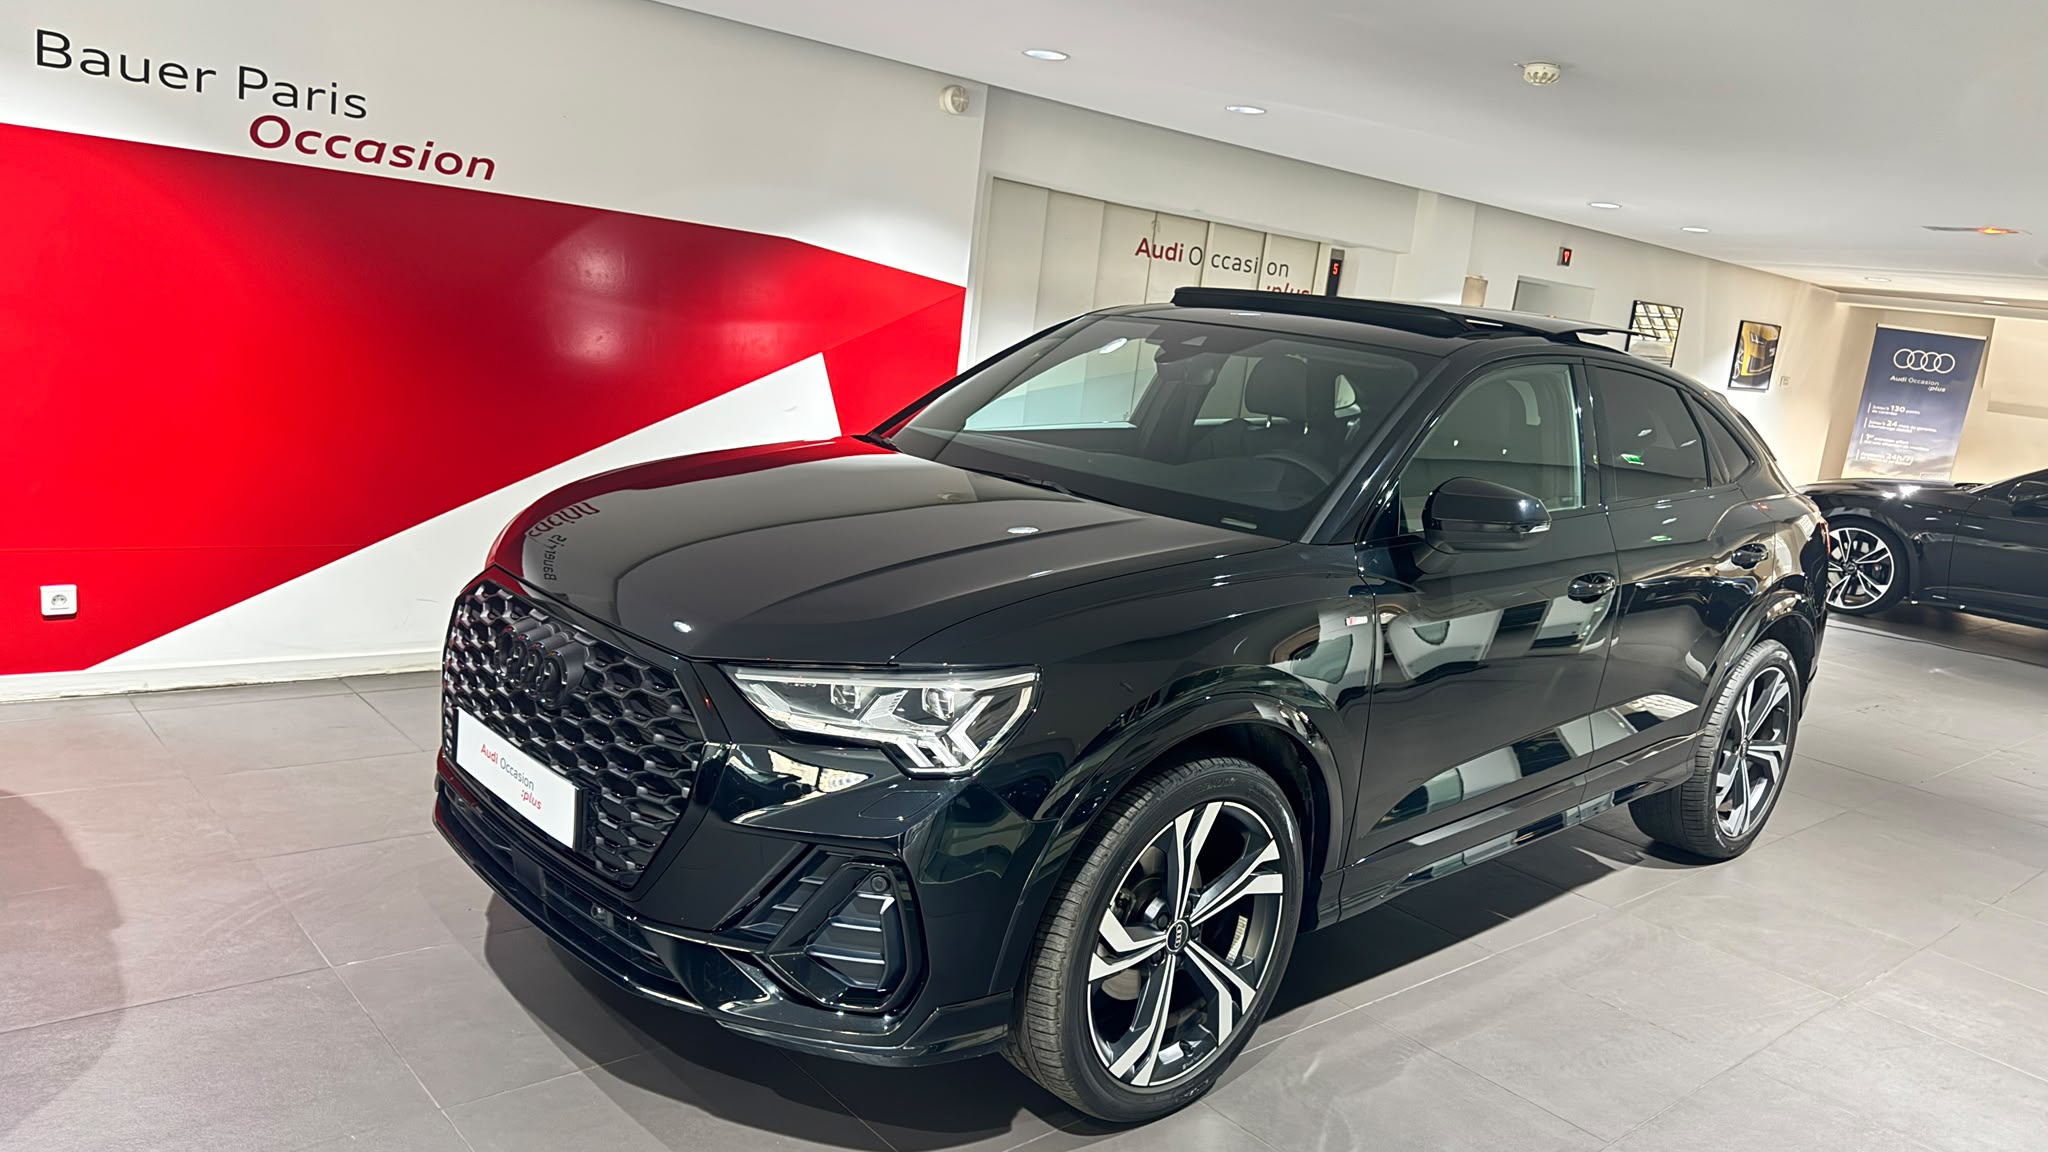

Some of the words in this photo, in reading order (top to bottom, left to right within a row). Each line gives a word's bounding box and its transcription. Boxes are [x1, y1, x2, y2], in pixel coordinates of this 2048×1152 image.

[35, 28, 217, 94] Bauer
[237, 65, 368, 120] Paris
[249, 114, 497, 182] Occasion
[1134, 237, 1185, 263] Audi
[1890, 375, 1907, 383] Audi
[1908, 377, 1940, 386] Occasion
[1890, 404, 1906, 413] 130
[1886, 419, 1898, 428] 24
[480, 743, 499, 765] Audi
[499, 757, 535, 792] Occasion
